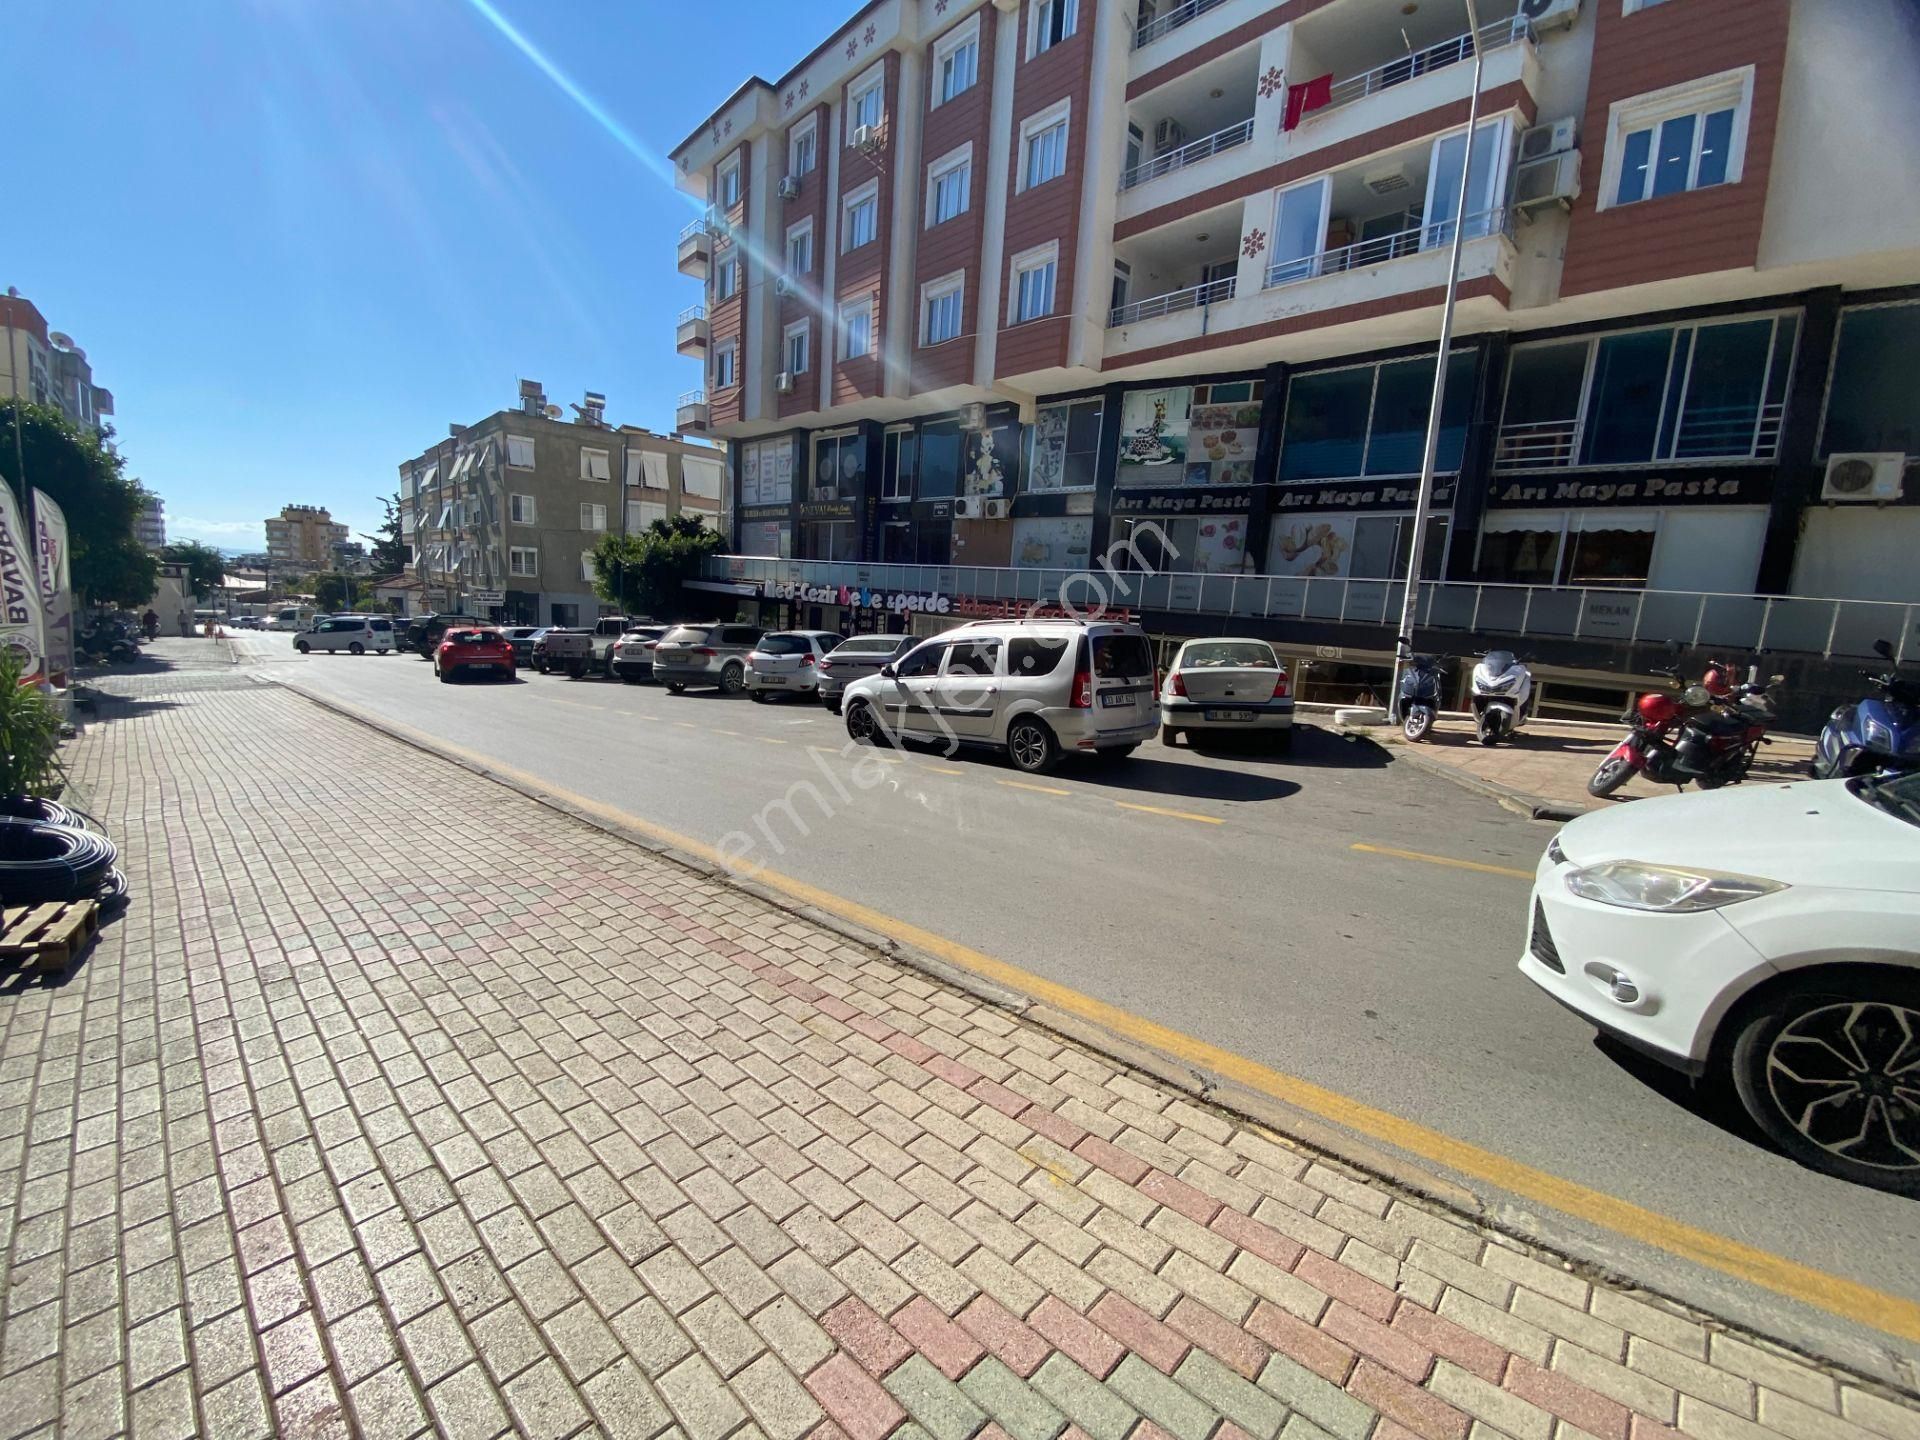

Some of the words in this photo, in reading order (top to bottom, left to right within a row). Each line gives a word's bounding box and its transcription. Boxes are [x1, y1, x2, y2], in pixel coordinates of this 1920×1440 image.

[1316, 490, 1376, 506] Maya
[1380, 487, 1450, 502] Pasa
[1553, 481, 1636, 501] Maya
[1643, 478, 1740, 497] Pasta
[1148, 495, 1196, 512] Maya
[838, 584, 883, 609] bebe
